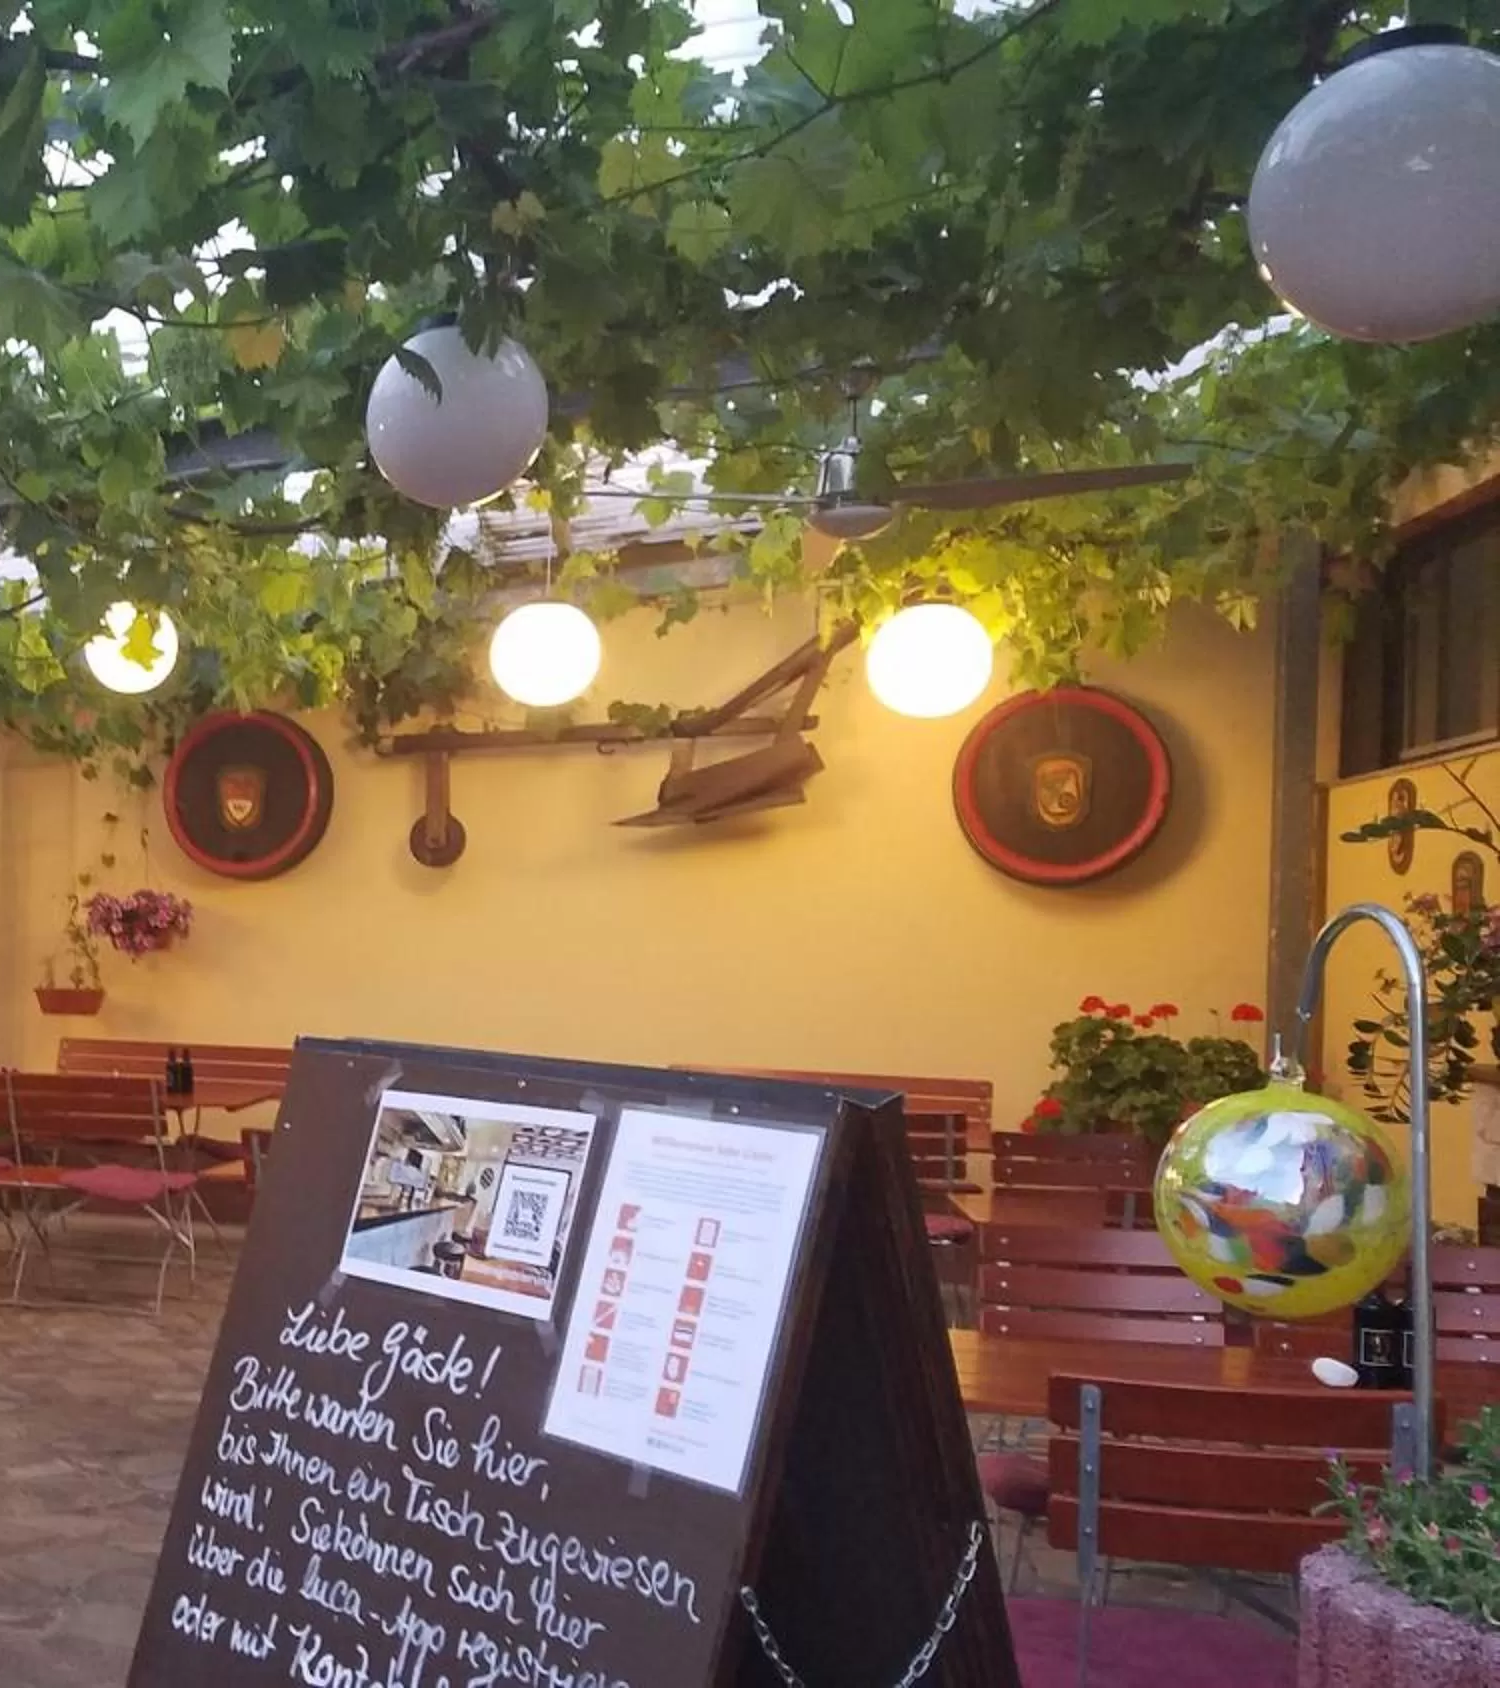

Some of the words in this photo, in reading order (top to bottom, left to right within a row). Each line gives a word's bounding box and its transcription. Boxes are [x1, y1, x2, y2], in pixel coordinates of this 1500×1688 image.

[279, 1301, 369, 1361] Liebe
[361, 1321, 502, 1401] Gäste!
[230, 1356, 302, 1419] Bitte
[304, 1388, 399, 1450] warten
[412, 1407, 462, 1468] Sie
[187, 1522, 244, 1577] über
[246, 1546, 287, 1595] die
[217, 1416, 256, 1466] bis
[260, 1431, 342, 1496] Ihnen
[347, 1462, 395, 1516] ein
[402, 1464, 493, 1551] Tisch
[494, 1511, 700, 1623] zugewiesen
[171, 1592, 225, 1644] oder
[230, 1613, 277, 1660] mit
[447, 1564, 524, 1626] sich
